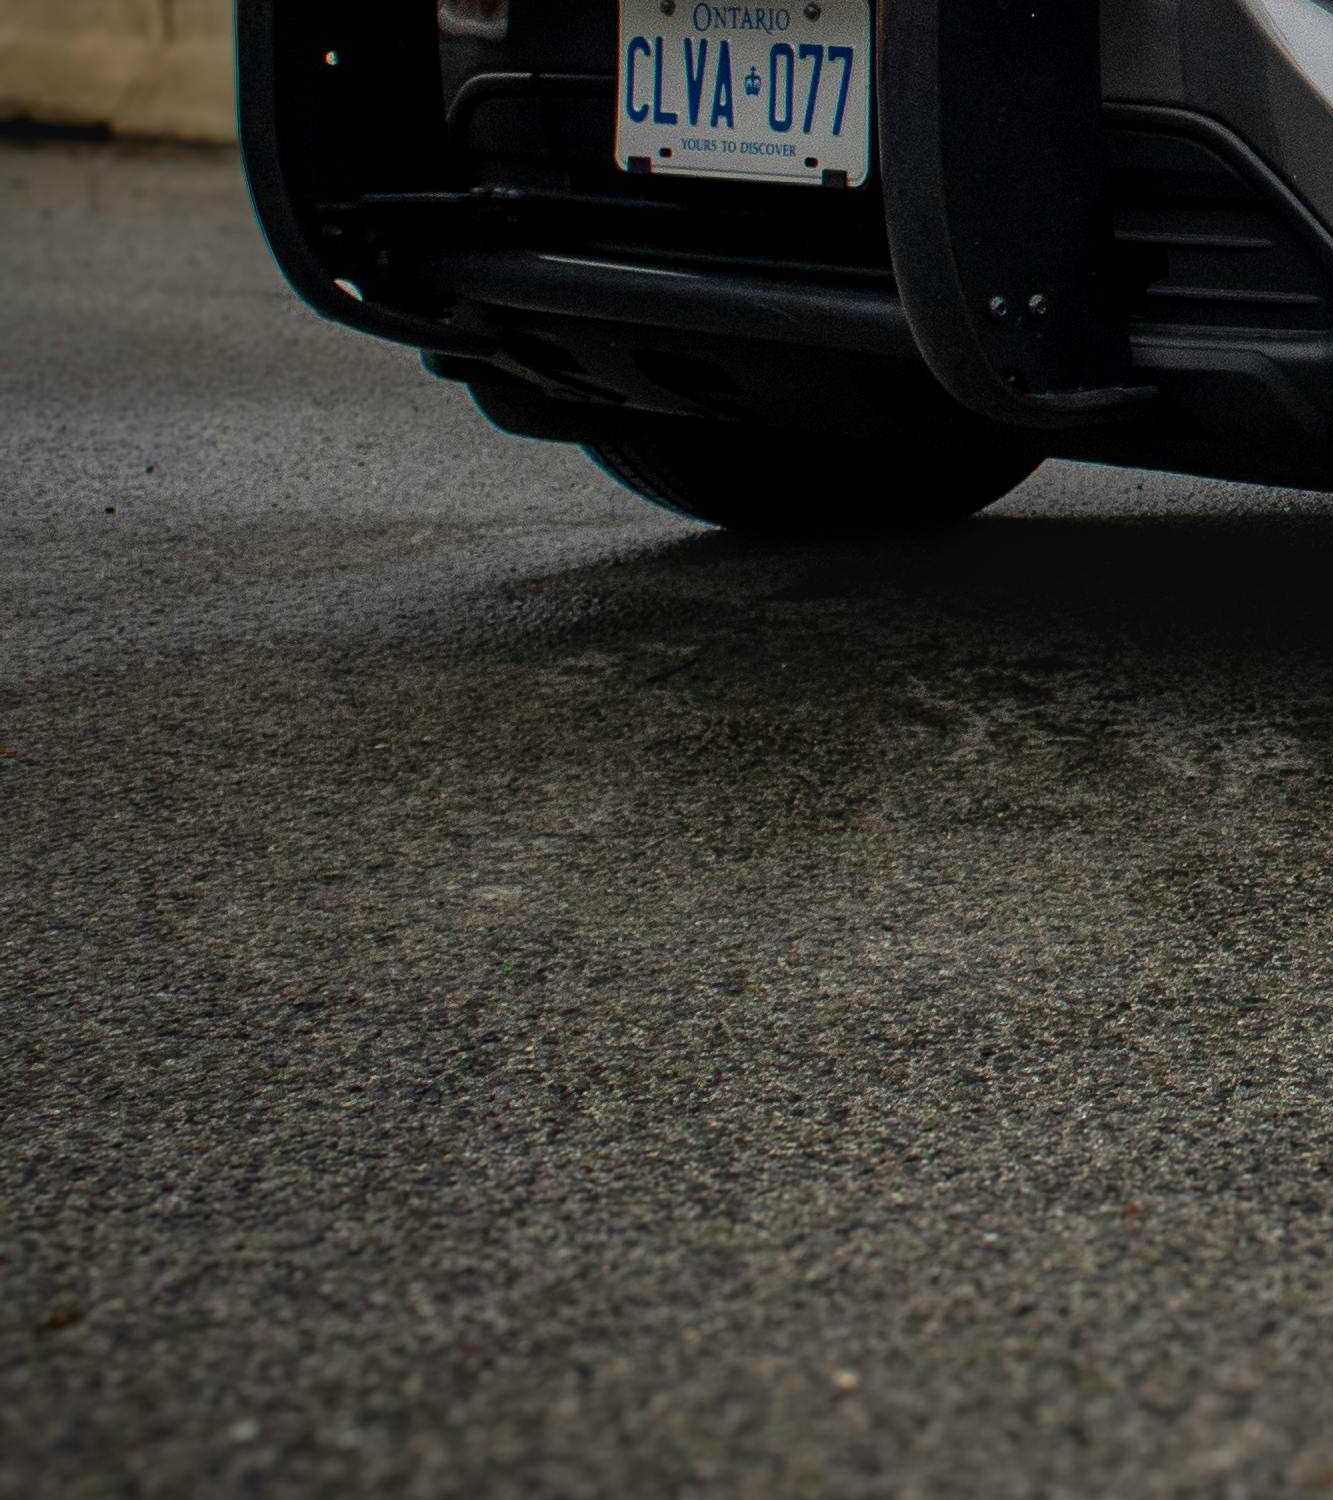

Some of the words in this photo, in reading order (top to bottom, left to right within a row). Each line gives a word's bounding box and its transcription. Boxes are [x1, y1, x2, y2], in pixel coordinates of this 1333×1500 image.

[693, 2, 790, 34] ONTARIO
[626, 35, 734, 129] CLVA
[768, 42, 854, 137] 077
[681, 138, 718, 153] YOURS
[722, 139, 738, 154] TO
[739, 141, 797, 158] DISCOVER
